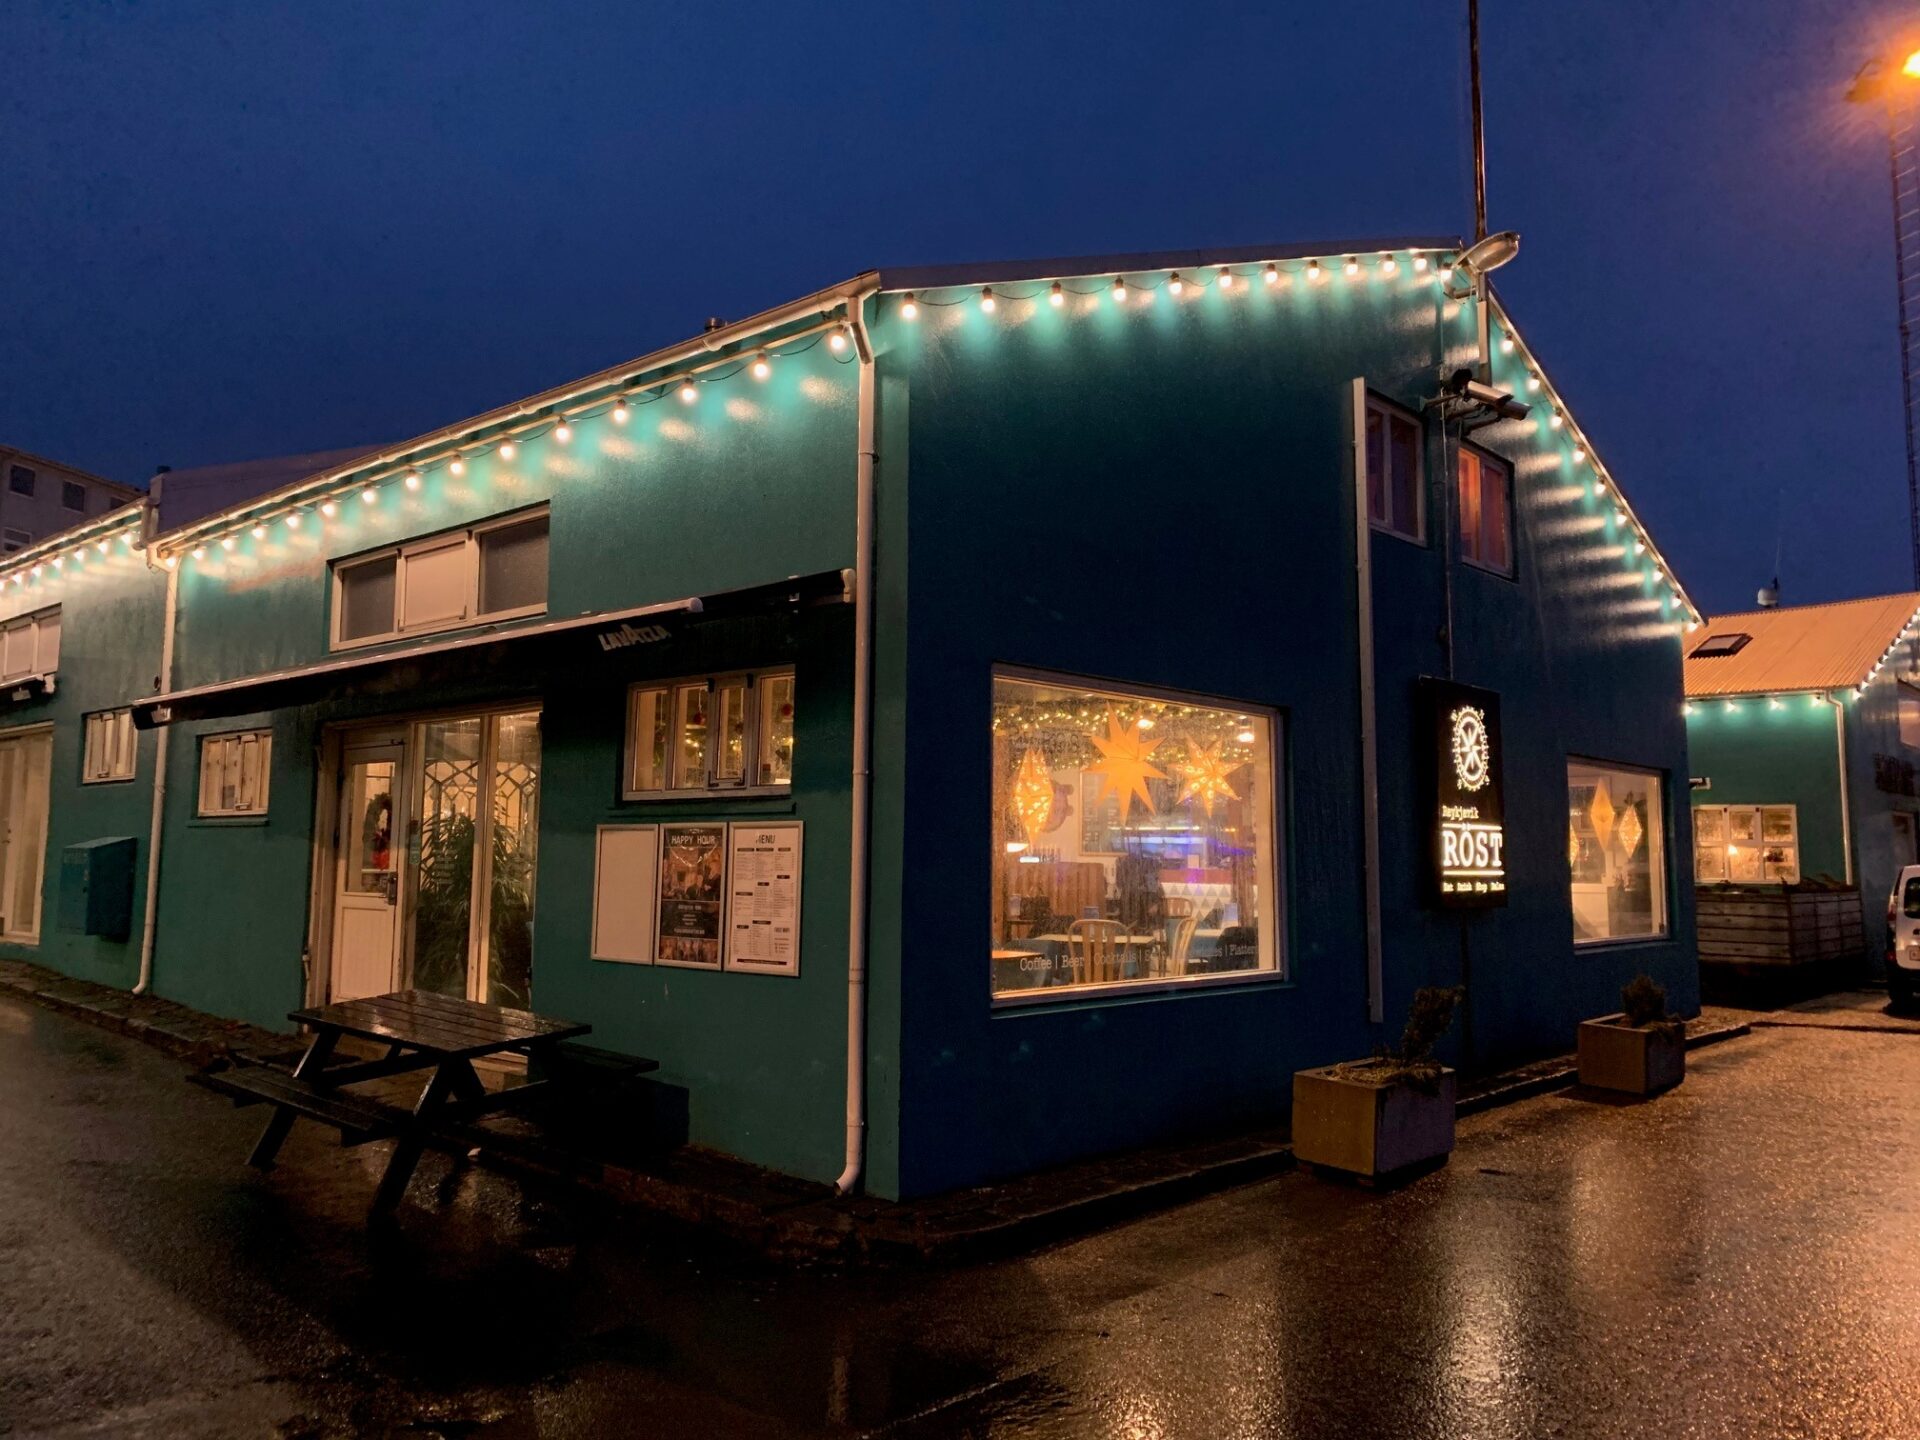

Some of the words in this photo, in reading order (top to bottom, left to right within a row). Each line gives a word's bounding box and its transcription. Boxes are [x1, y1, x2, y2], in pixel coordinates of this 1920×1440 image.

[671, 835, 693, 845] HAPPY
[696, 835, 716, 845] HOUR
[1442, 823, 1503, 867] RÖST
[1020, 956, 1052, 971] Coffee
[1061, 954, 1084, 968] Beer
